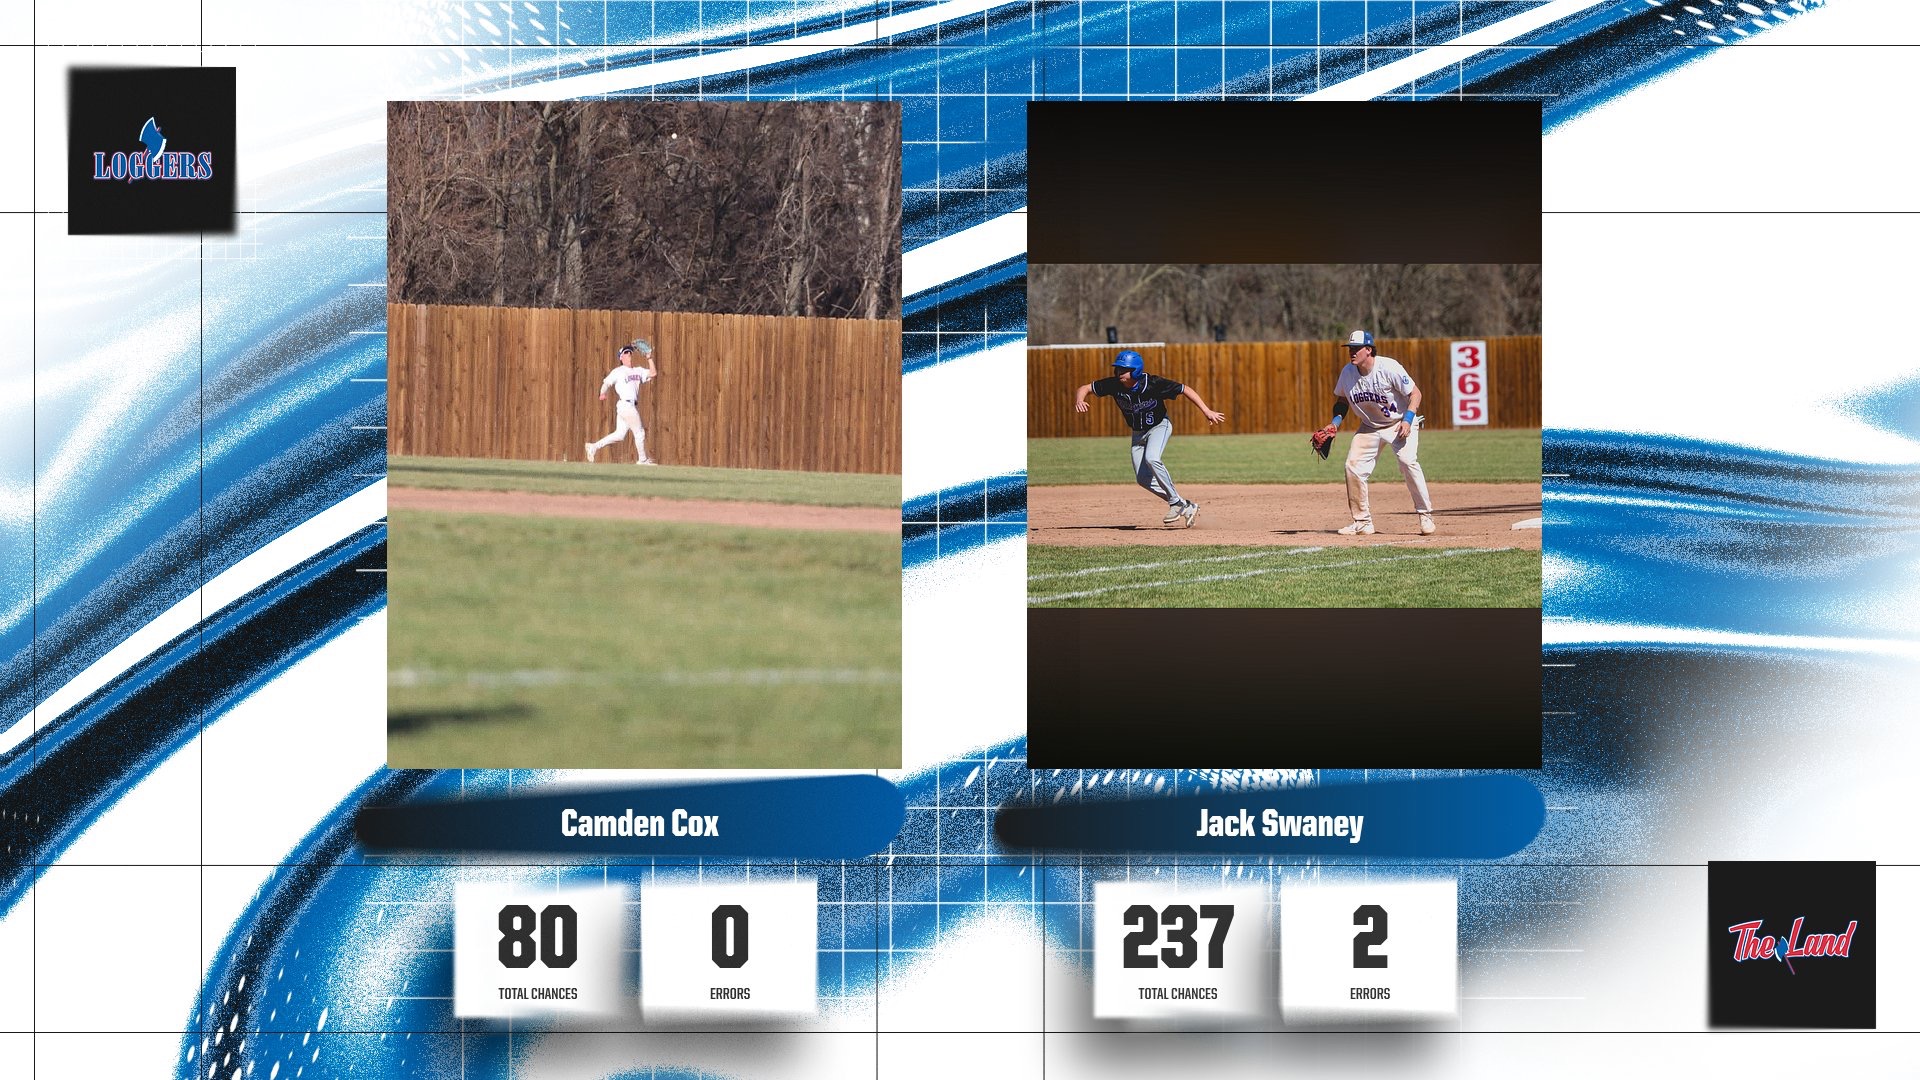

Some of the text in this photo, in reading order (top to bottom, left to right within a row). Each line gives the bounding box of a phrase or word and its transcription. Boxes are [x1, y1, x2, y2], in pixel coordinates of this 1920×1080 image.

[1458, 345, 1481, 420] 365
[1381, 402, 1397, 418] 34
[1146, 412, 1154, 425] 5
